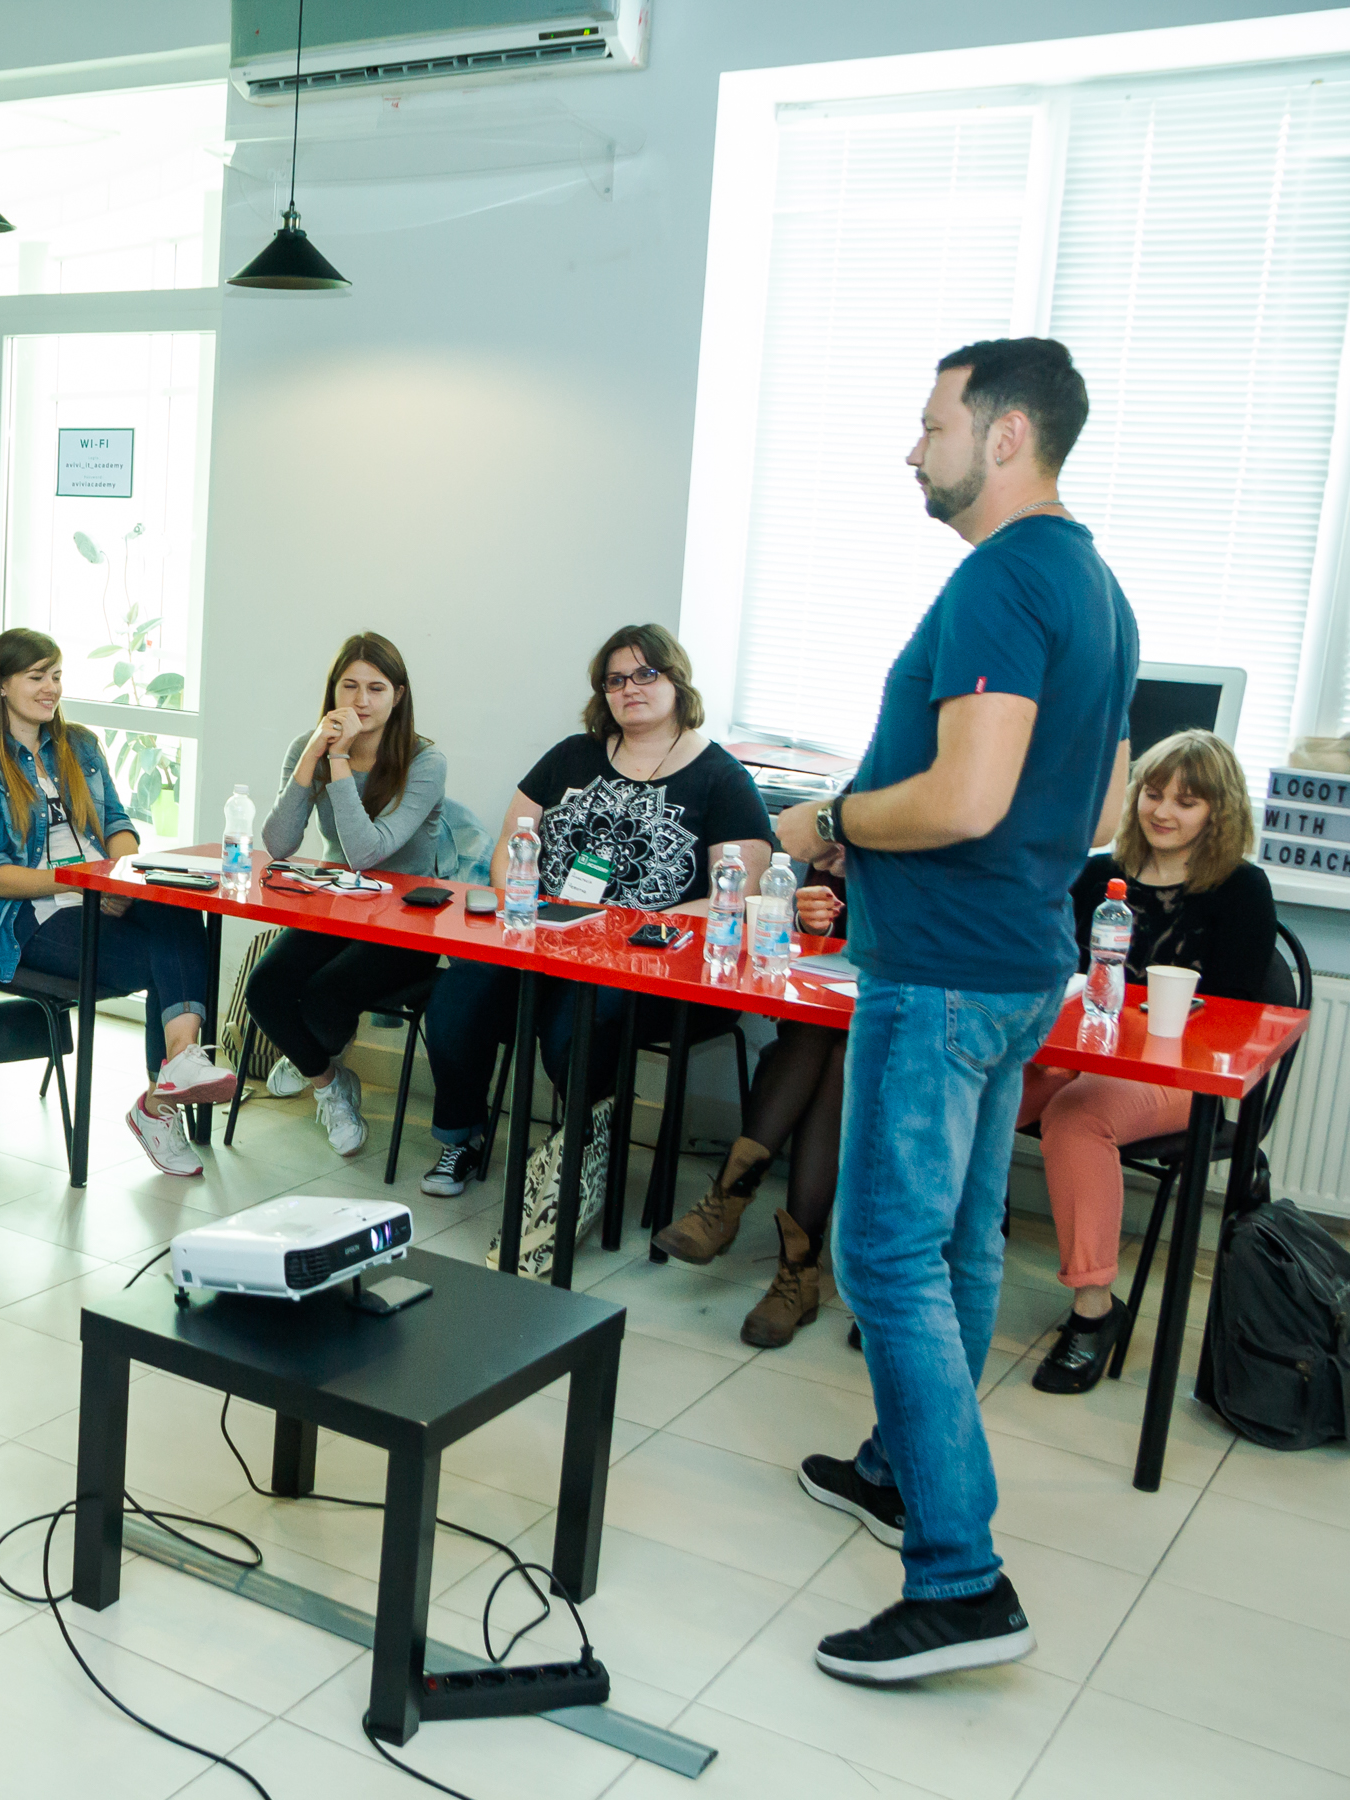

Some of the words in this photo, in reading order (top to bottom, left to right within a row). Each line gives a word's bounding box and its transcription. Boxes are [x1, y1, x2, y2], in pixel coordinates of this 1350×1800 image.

[80, 438, 109, 449] WI-FI
[65, 462, 124, 470] avivi_it_academy
[71, 481, 116, 489] aviviacademy
[1271, 776, 1348, 803] LOGOT
[1265, 808, 1326, 835] WITH
